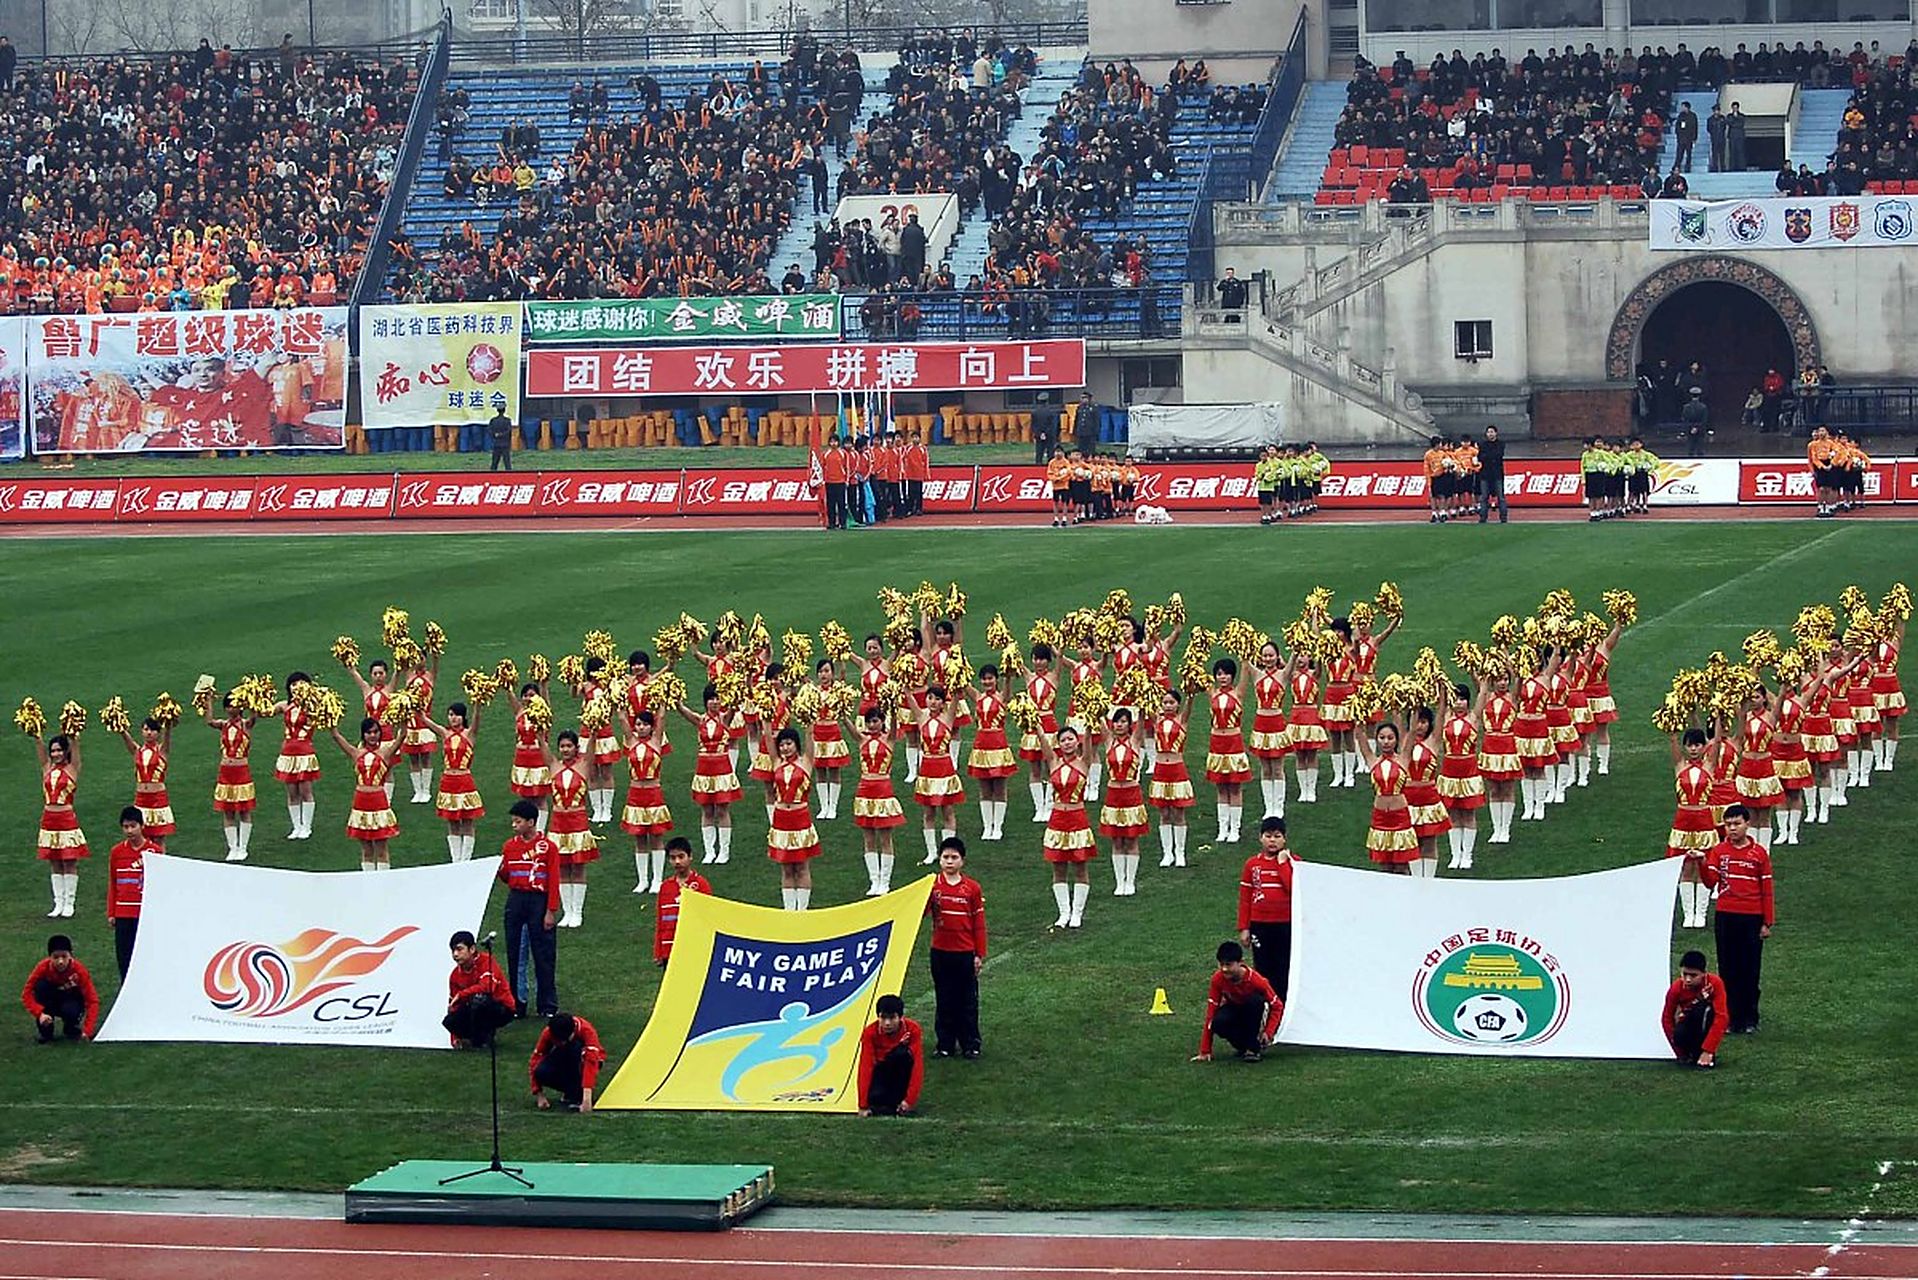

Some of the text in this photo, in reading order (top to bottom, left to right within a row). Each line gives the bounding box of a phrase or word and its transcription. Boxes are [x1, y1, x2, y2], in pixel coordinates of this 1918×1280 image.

[373, 314, 514, 337] 湖北省医药科技界
[533, 300, 835, 331] 球迷感谢你! 金威啤酒
[42, 312, 324, 358] 鲁广超级球迷
[563, 345, 1050, 393] 团结 欢乐 拼搏 向上
[448, 390, 507, 409] 球迷会
[432, 482, 536, 506] 金威啤酒
[574, 480, 680, 504] 金威啤酒
[1318, 472, 1427, 497] 金威啤酒
[1667, 483, 1700, 495] CSL
[1754, 471, 1880, 496] 金威酒
[19, 486, 117, 509] 金威啤酒
[153, 487, 252, 511] 金威啤酒
[290, 485, 392, 509] 金威啤酒
[724, 937, 879, 972] MY GAME IS
[1423, 927, 1562, 973] 中国足球协会
[720, 956, 875, 993] FAIR PLAY
[313, 991, 399, 1022] CSL
[1478, 1013, 1501, 1029] CFA
